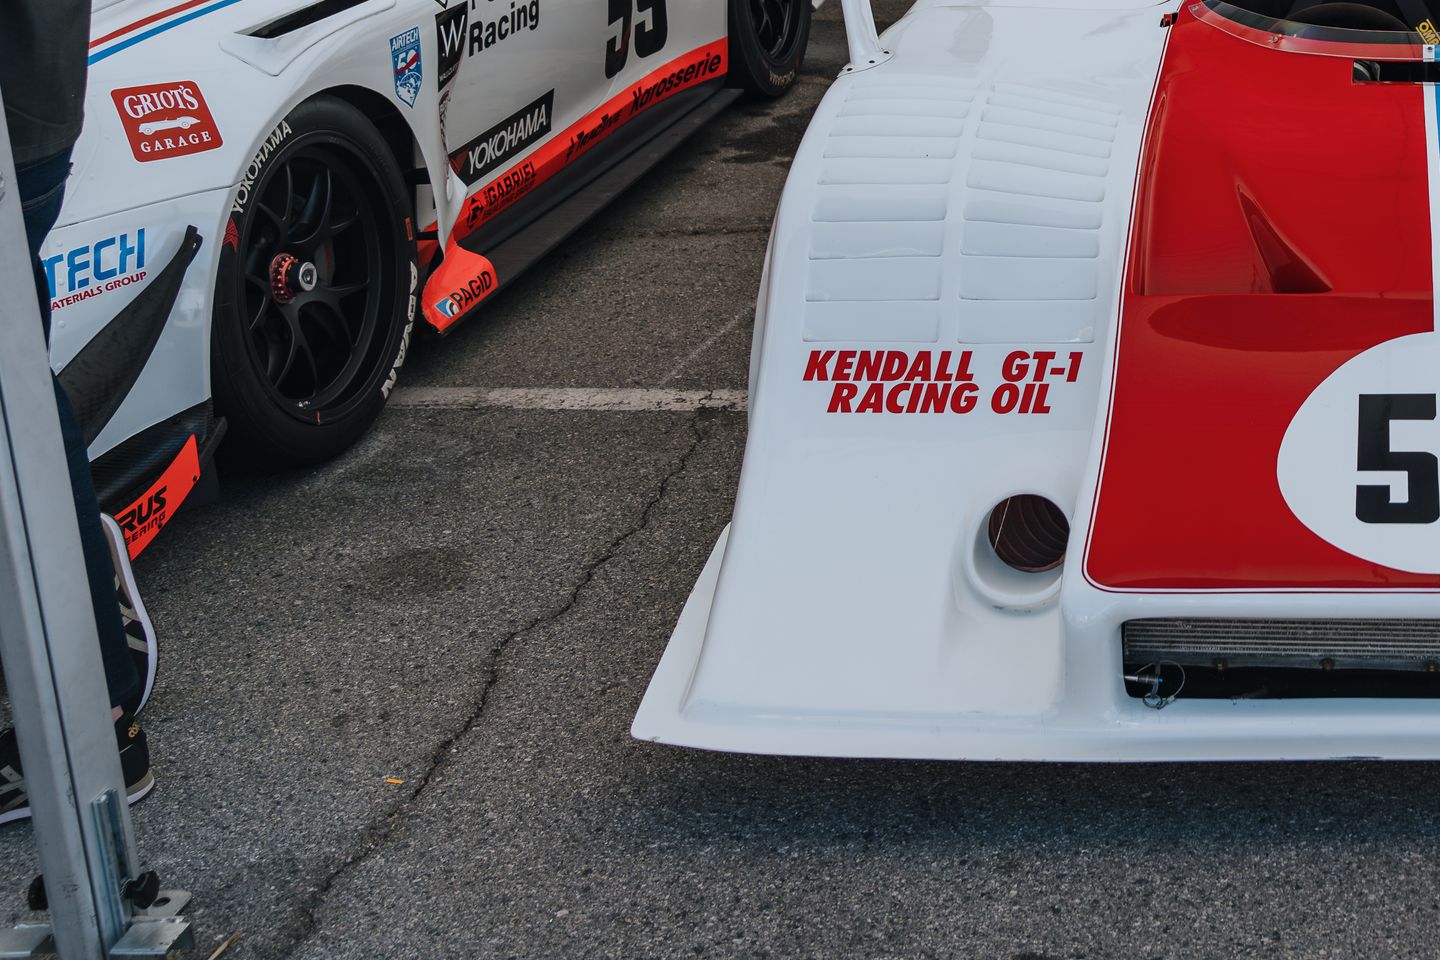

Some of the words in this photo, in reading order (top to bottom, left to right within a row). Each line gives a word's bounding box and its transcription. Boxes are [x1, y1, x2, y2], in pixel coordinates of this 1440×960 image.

[391, 28, 419, 52] AIRTECH
[123, 86, 200, 119] GRIOT'S
[141, 130, 212, 154] GARAGE
[468, 103, 548, 175] YOKOHAMA
[231, 120, 292, 214] YOKOHAMA
[487, 161, 536, 206] GABRIEL
[105, 271, 147, 292] GROUP
[449, 270, 492, 311] PAGID
[380, 260, 418, 400] ADVAN
[802, 350, 974, 382] KENDALL
[1001, 350, 1084, 383] GT-1
[827, 383, 980, 414] RACING
[990, 383, 1052, 414] OIL
